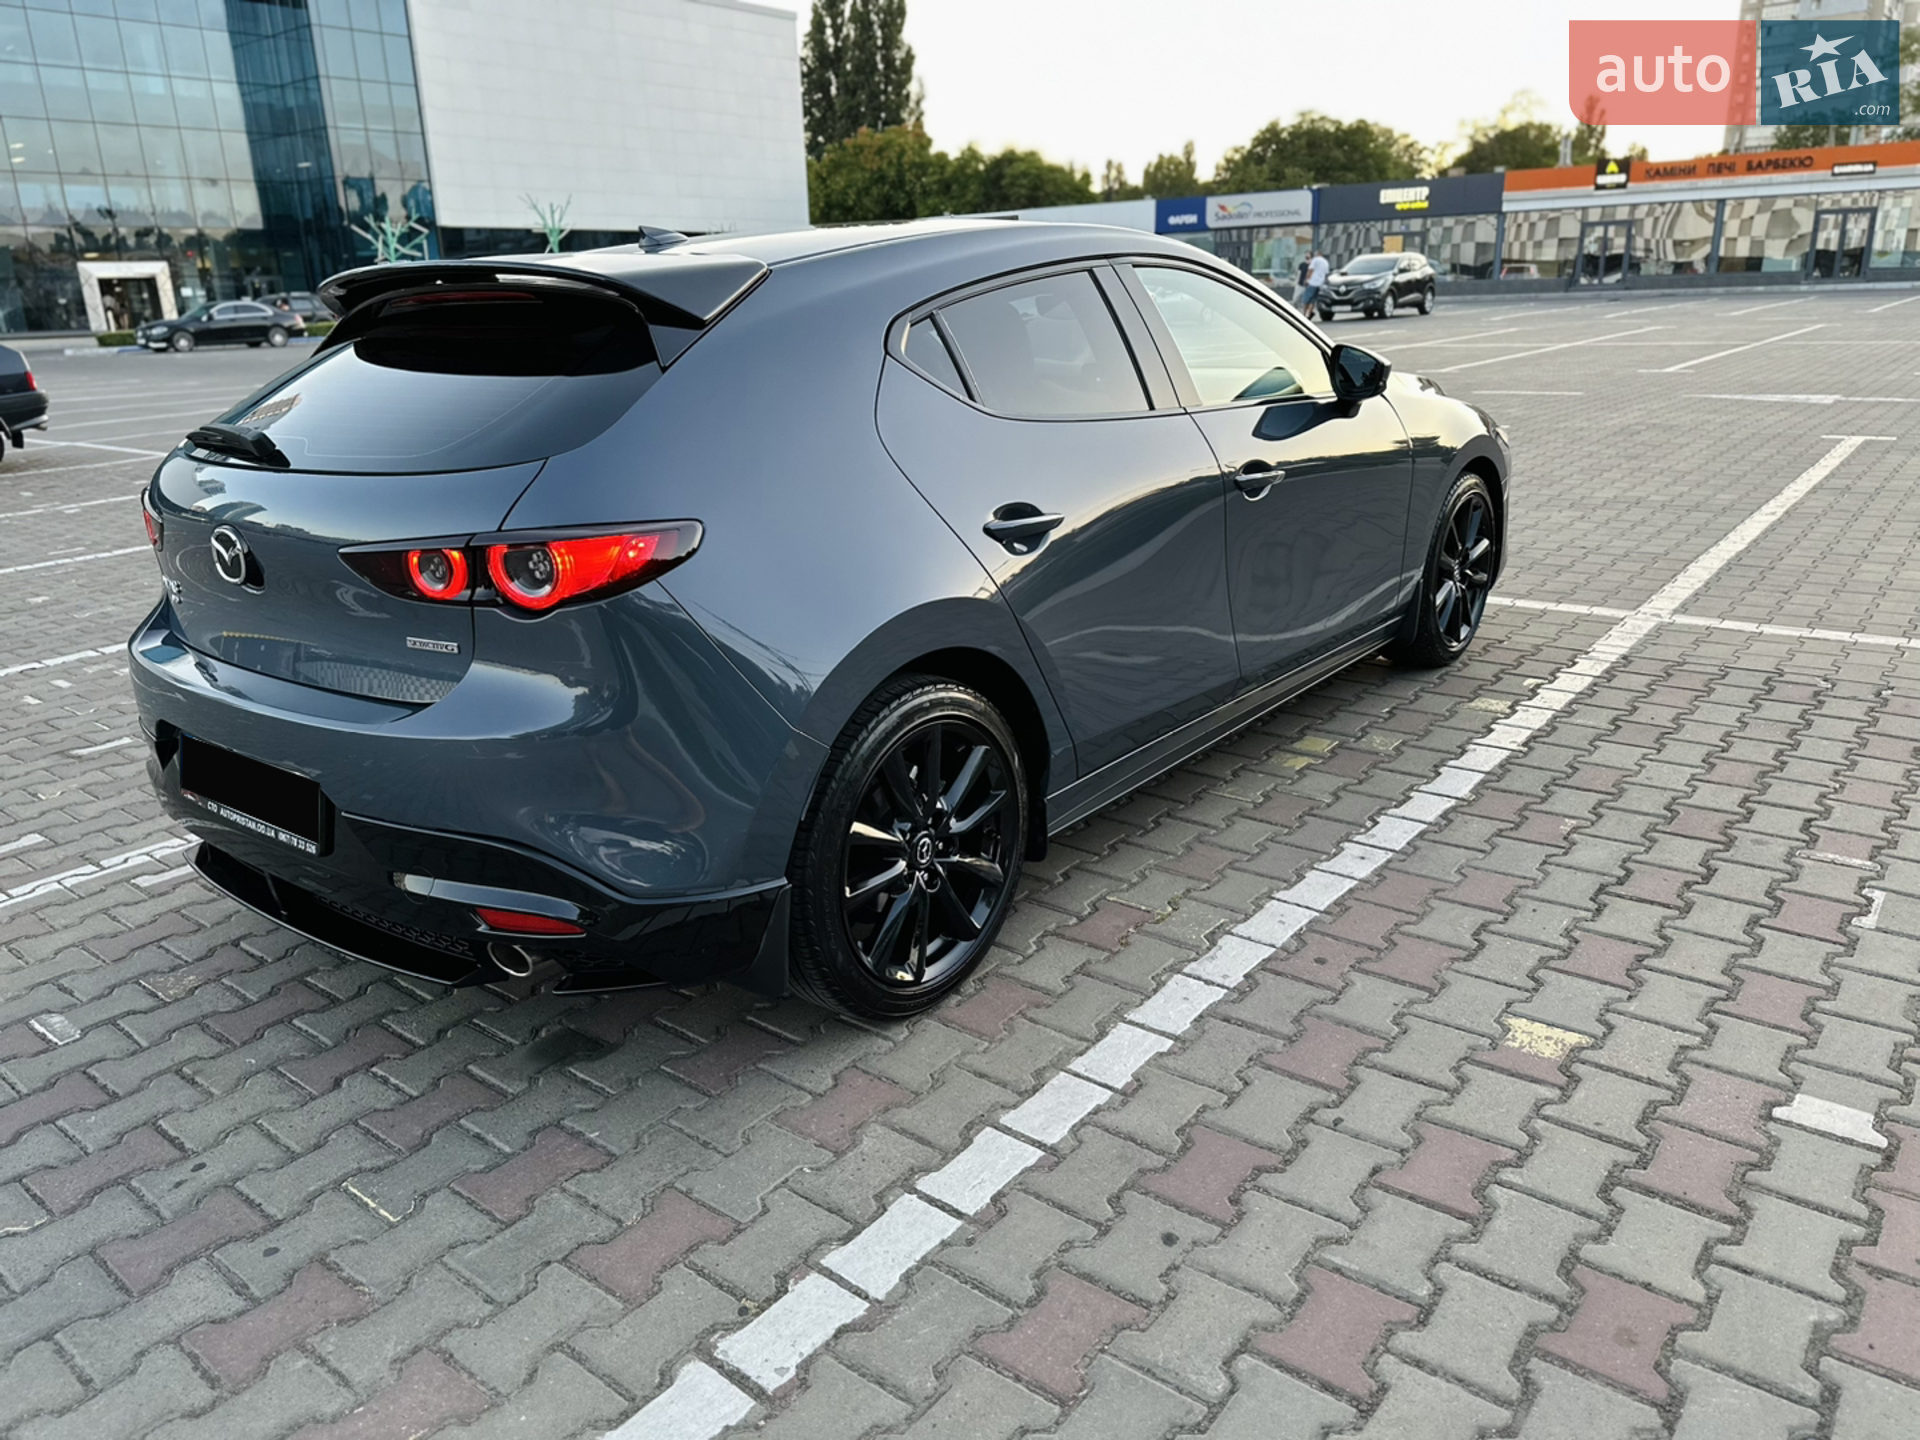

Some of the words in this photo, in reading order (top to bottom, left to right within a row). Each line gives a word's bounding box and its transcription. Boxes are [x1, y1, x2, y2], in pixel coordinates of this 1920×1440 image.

[1707, 161, 1736, 174] ПЕЧІ
[1746, 156, 1814, 171] БАРБЕКЮ
[1214, 210, 1248, 222] Sadolin
[1253, 209, 1301, 219] PROFESSIONAL
